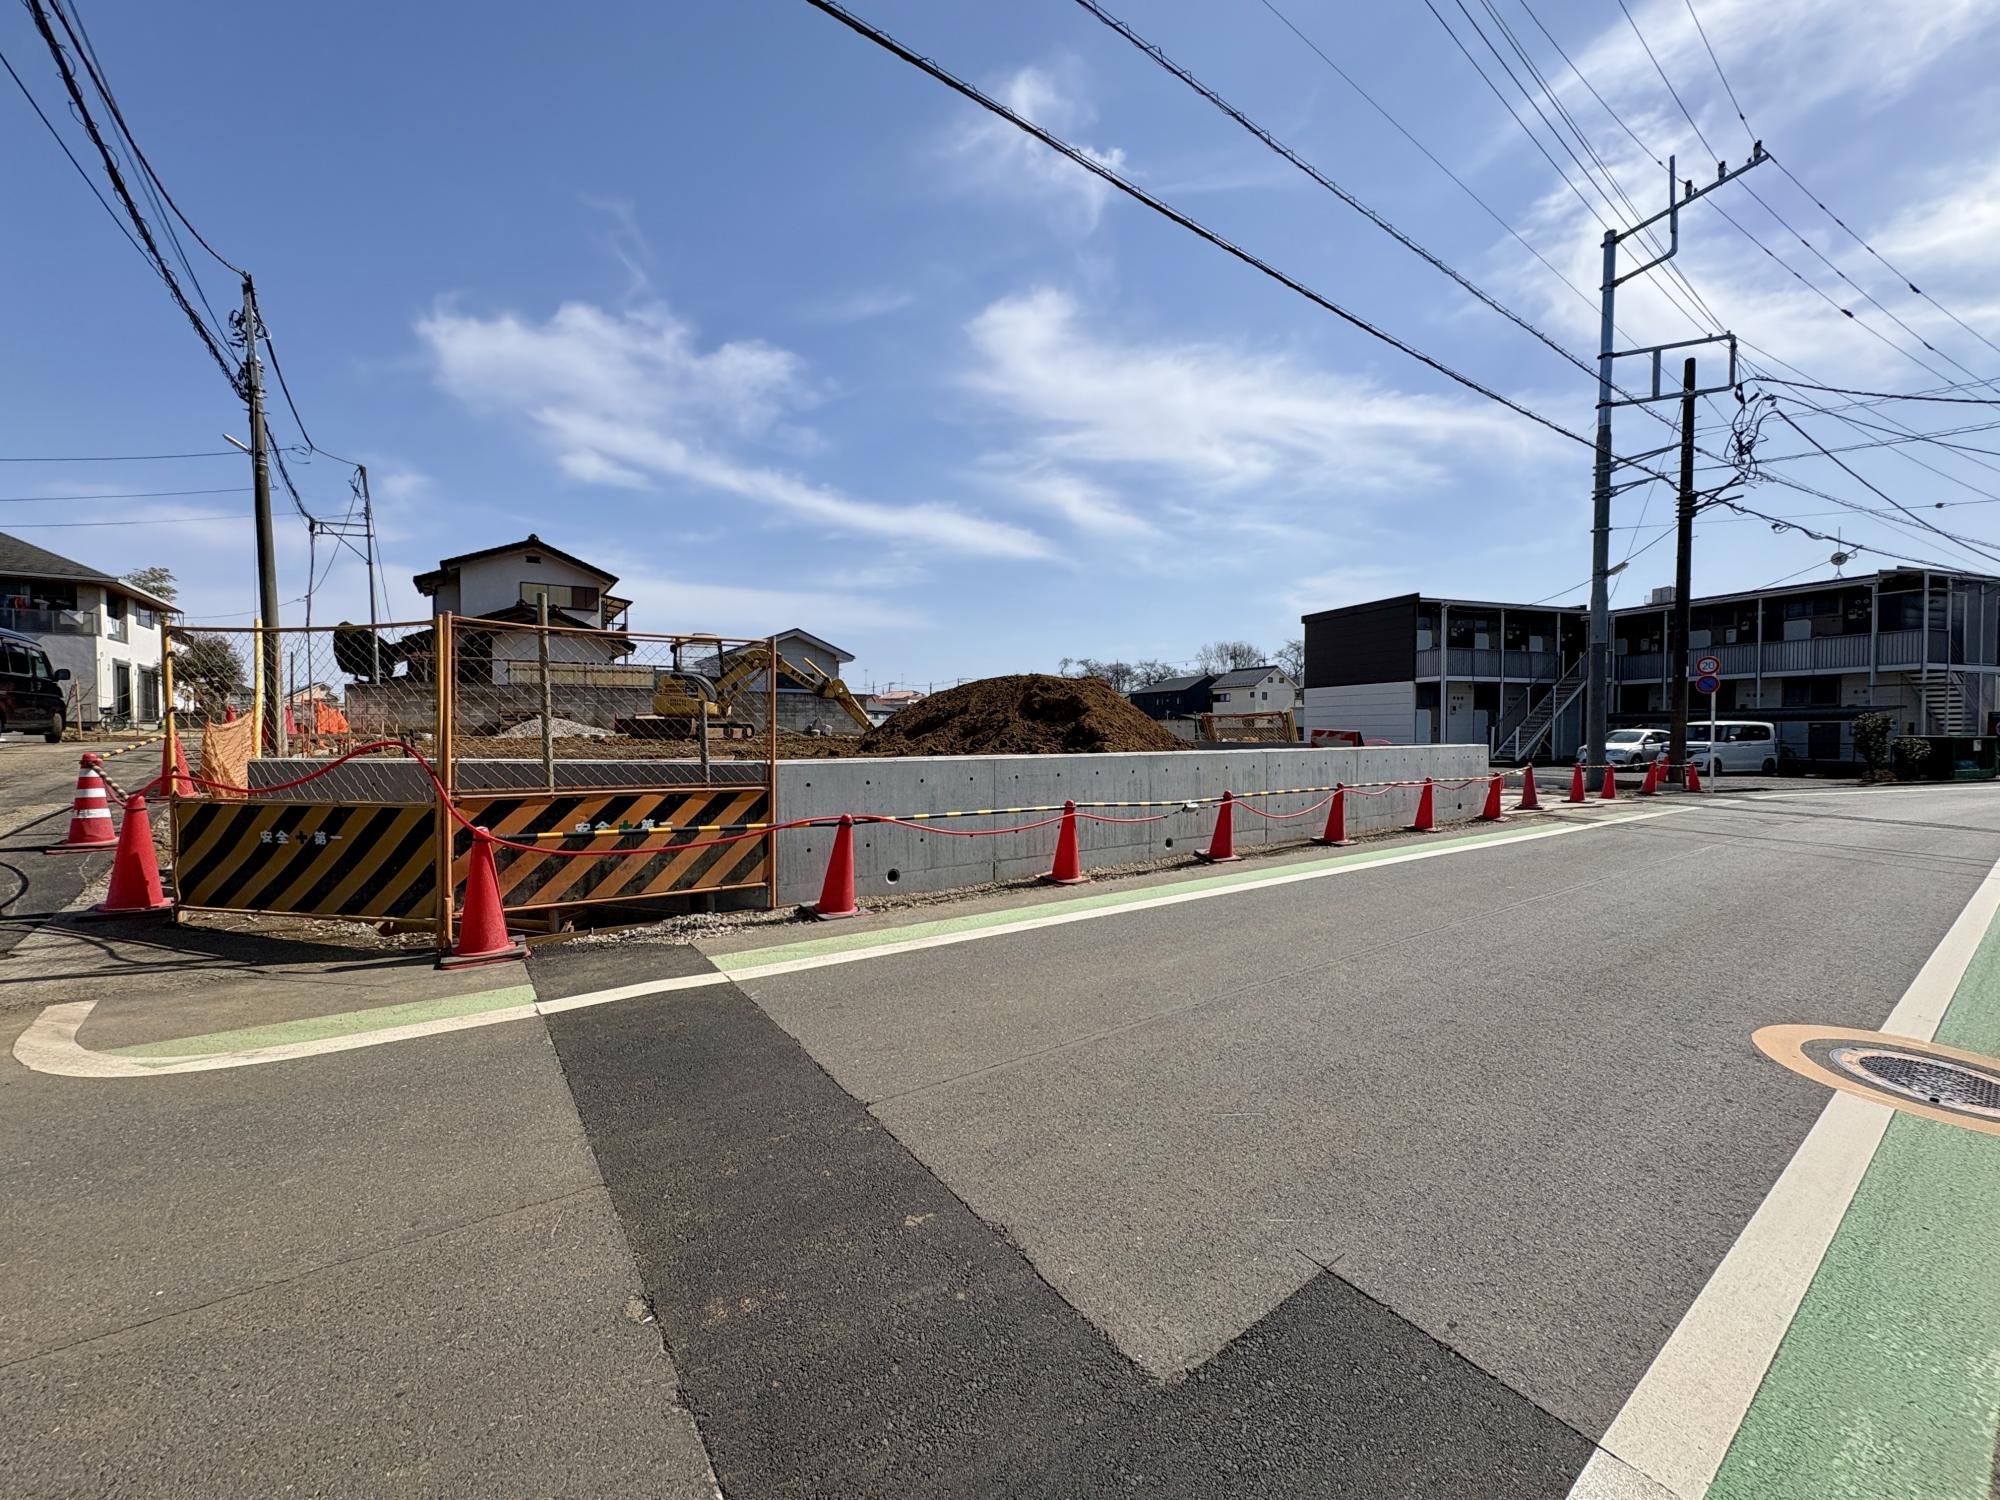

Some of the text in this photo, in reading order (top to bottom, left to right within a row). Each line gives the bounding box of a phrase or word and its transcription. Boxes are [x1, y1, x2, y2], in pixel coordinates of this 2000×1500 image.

[1702, 661, 1715, 670] 20
[260, 830, 343, 845] 安全 第一
